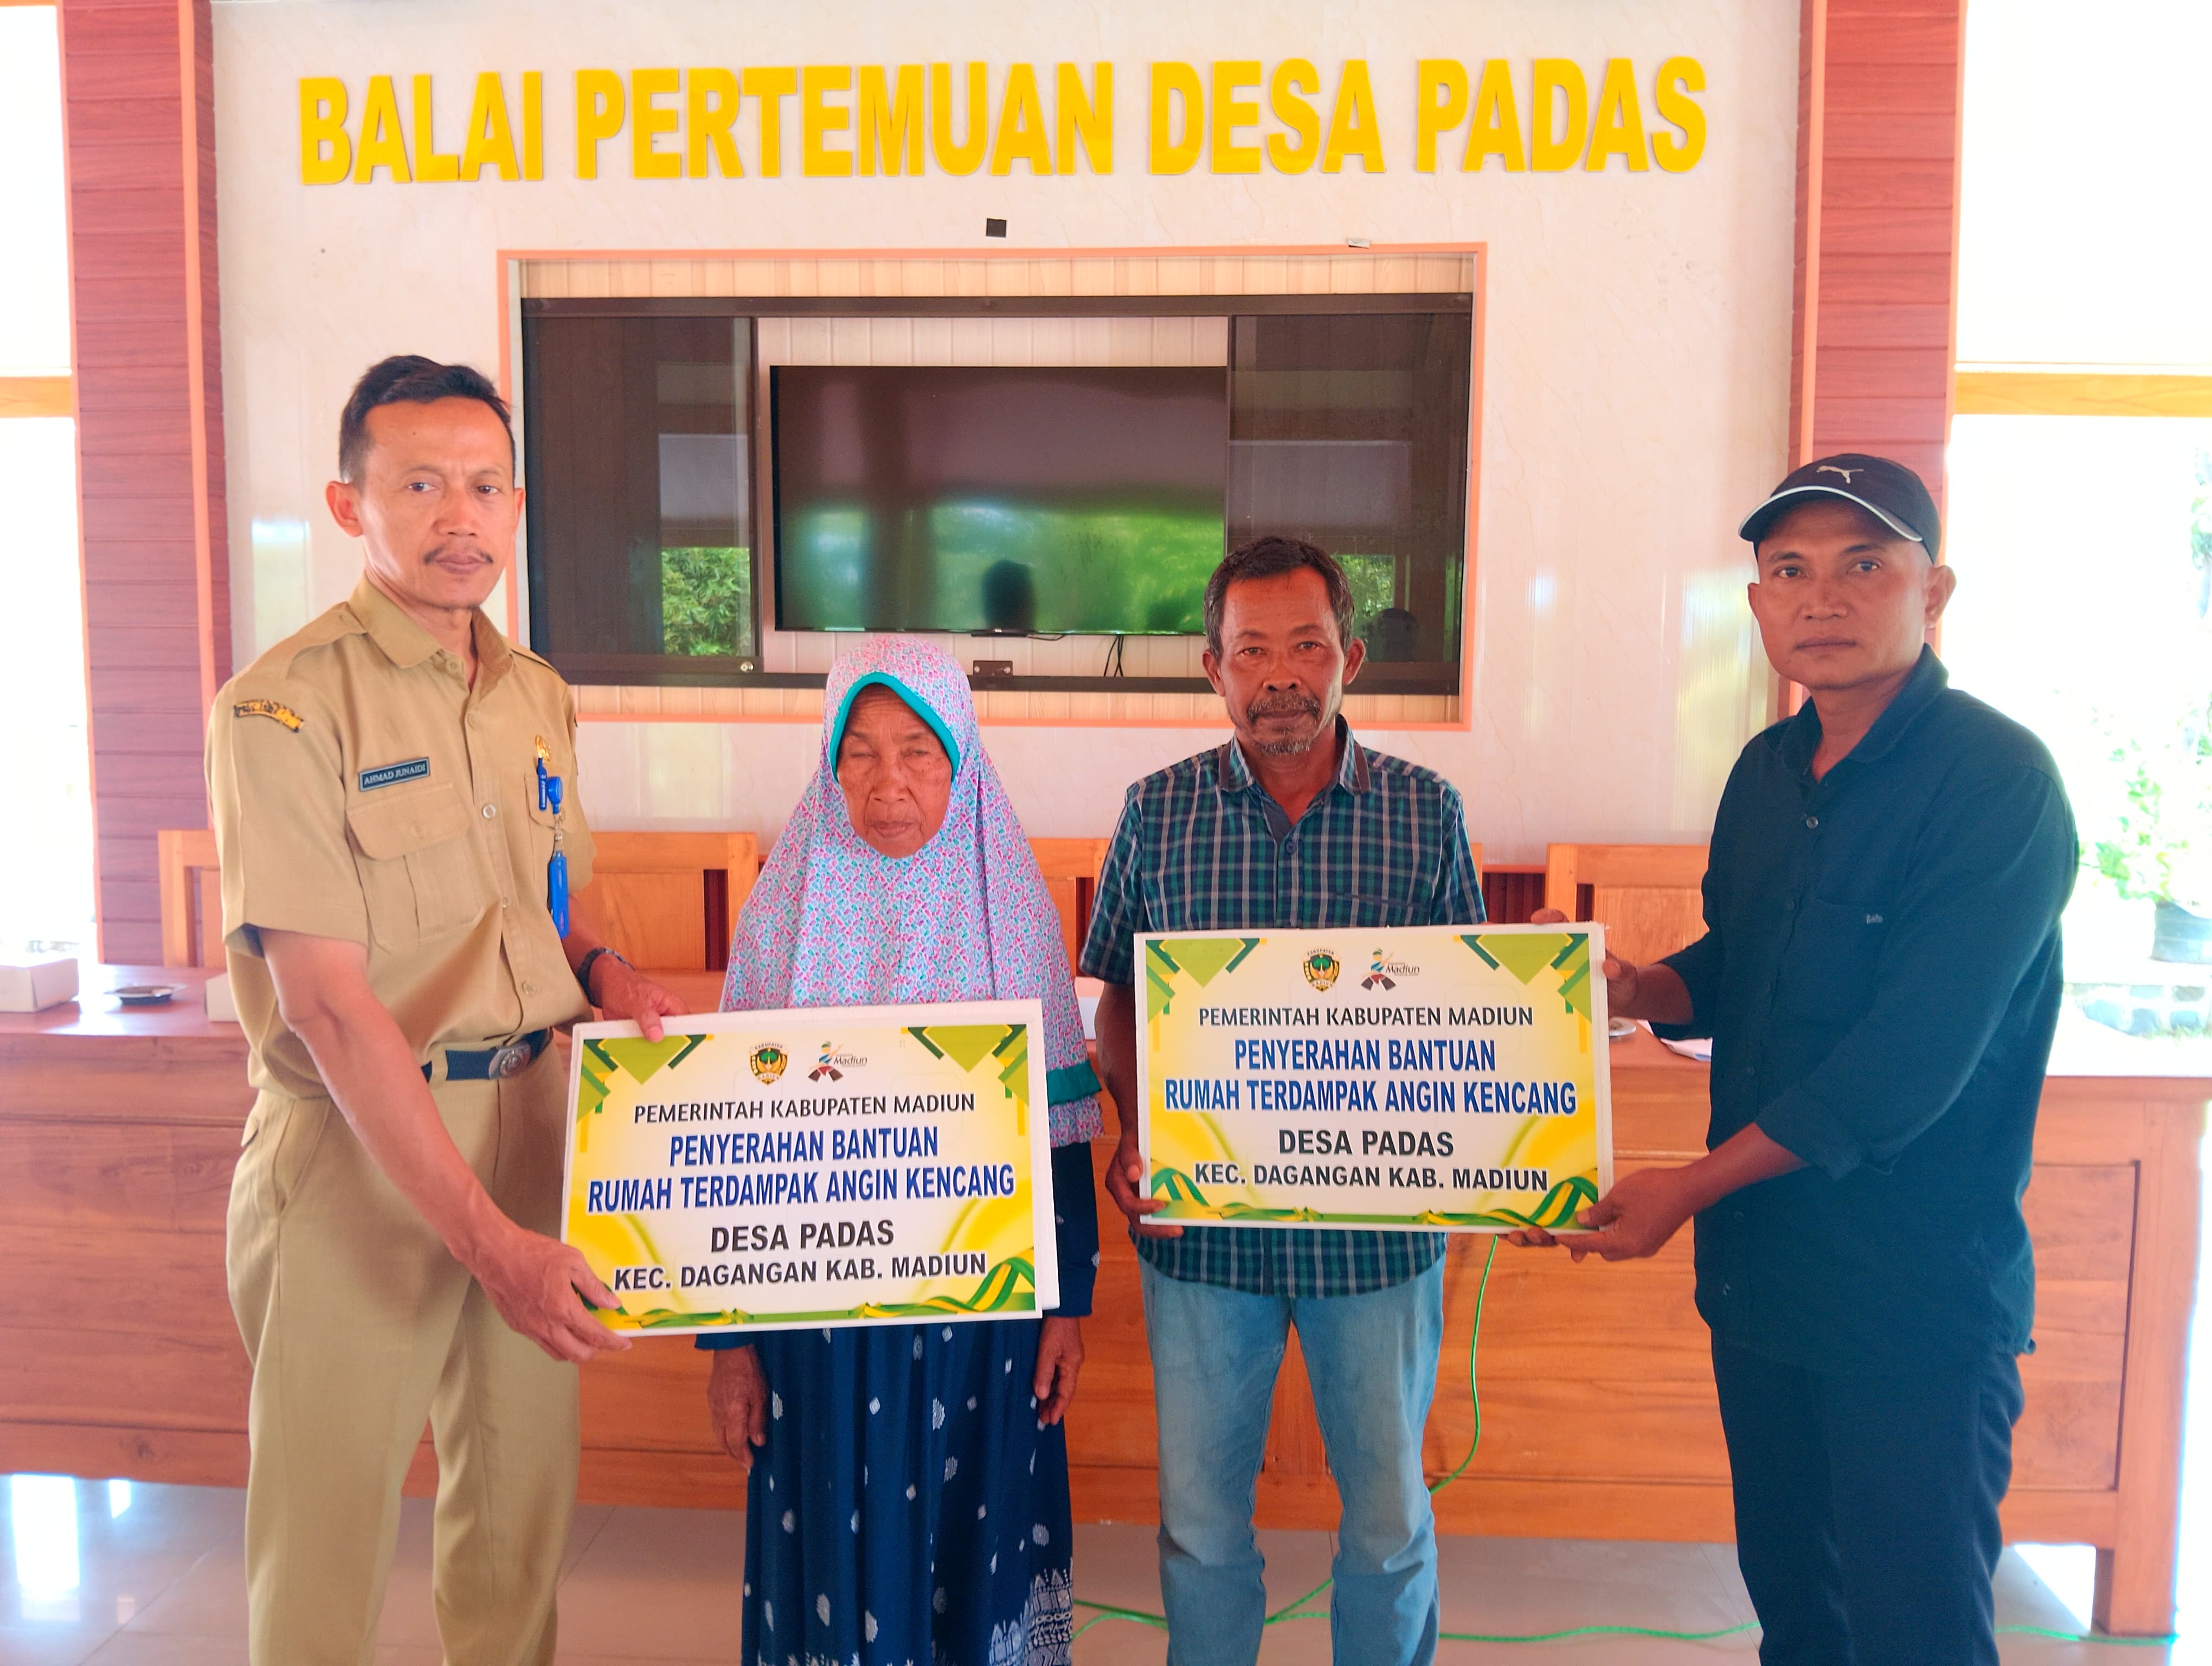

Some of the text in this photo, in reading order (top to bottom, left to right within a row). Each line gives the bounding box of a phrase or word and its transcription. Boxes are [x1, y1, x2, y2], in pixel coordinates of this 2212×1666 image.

[299, 56, 1707, 184] BALAI PERTEMUAN DESA PADAS
[364, 772, 394, 785] AHMAD
[1386, 964, 1420, 973] Madiun
[1199, 1007, 1533, 1026] PEMERINTAH KABUPATEN MADIUN
[834, 1055, 867, 1065] Madiun
[1235, 1040, 1495, 1071] PENYERAHAN BANTUAN
[634, 1093, 974, 1123] PEMERINTAH KABUPATEN MADIUN
[1166, 1079, 1576, 1114] RUMAH TERDAMPAK ANGIN KENCANG
[670, 1126, 937, 1167] PENYERAHAN BANTUAN
[1279, 1130, 1454, 1157] DESA PADAS
[588, 1164, 1014, 1212] RUMAH TERDAMPAK ANGIN KENCANG
[1194, 1163, 1548, 1191] KEC. DAGANGAN KAB. MADIUN
[711, 1220, 894, 1253] DESA PADAS
[615, 1253, 987, 1290] KEC. DAGANGAN KAB. MADIUN
